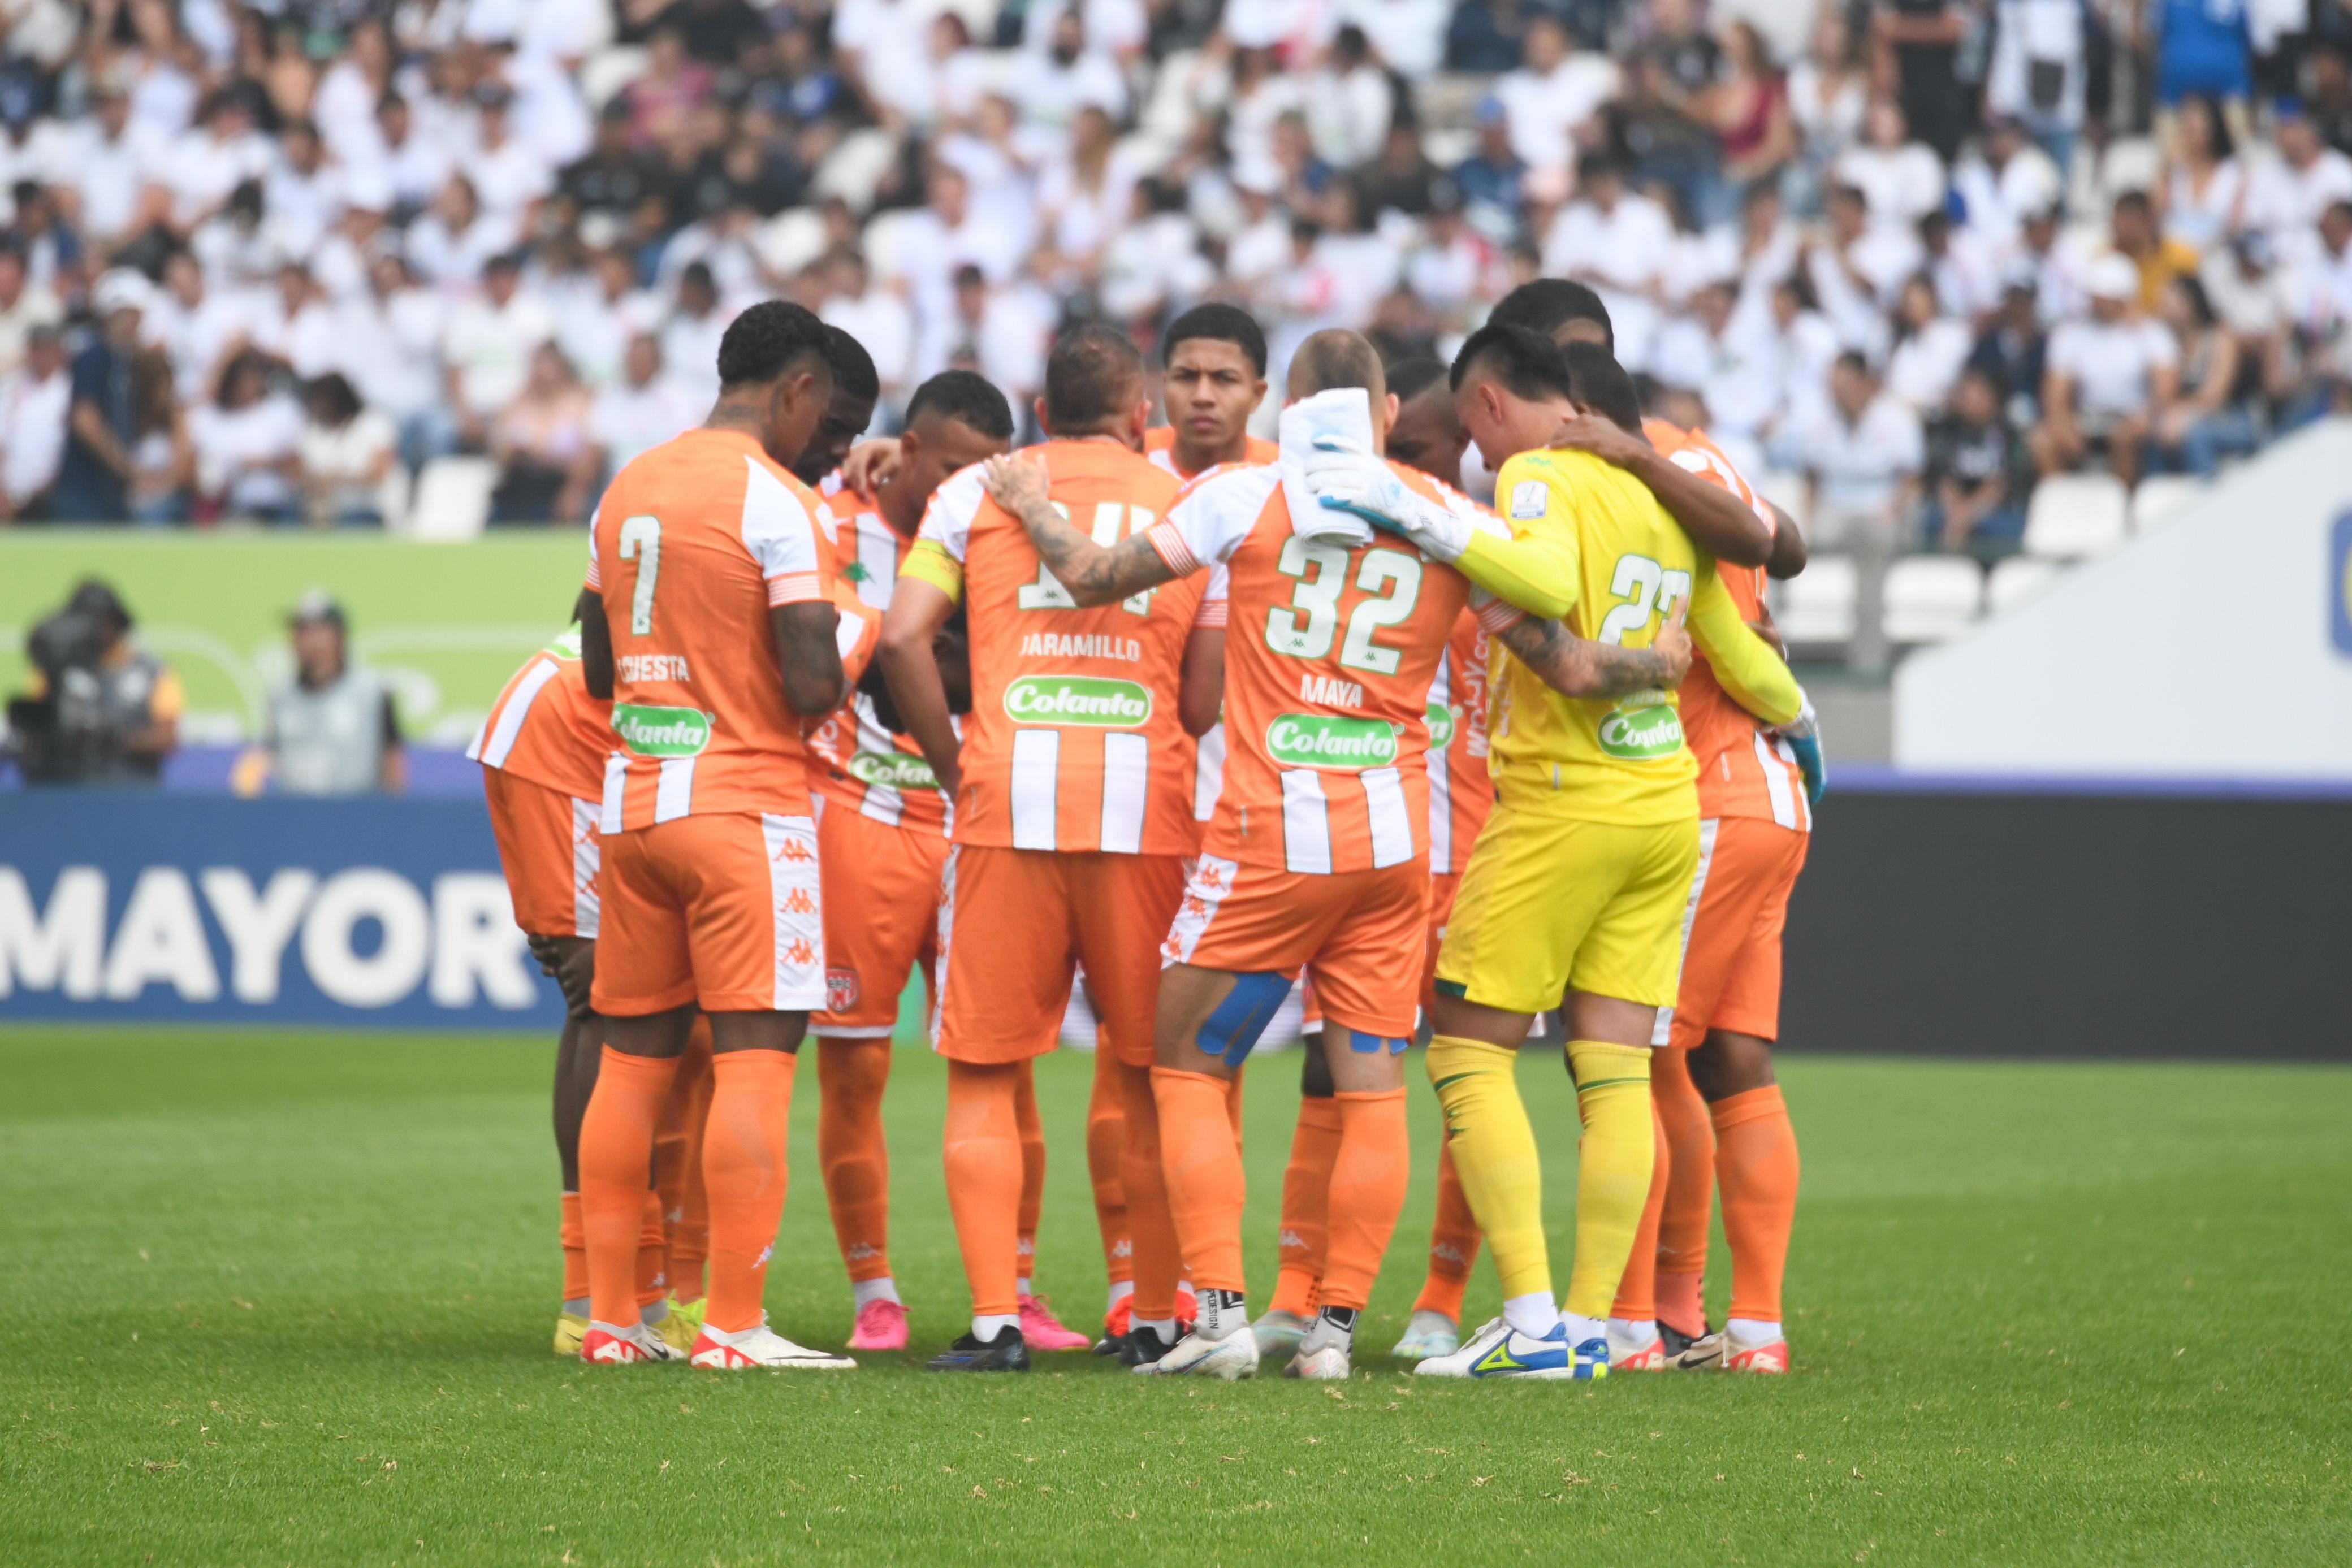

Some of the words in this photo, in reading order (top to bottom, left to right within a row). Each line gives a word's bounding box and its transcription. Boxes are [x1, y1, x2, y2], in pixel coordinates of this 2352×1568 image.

[619, 515, 662, 635] 7
[1264, 534, 1423, 675] 32
[1020, 633, 1142, 662] JARAMILLO
[1009, 685, 1145, 718] Colanta
[1300, 674, 1363, 708] MAYA
[1271, 722, 1393, 757] Colanta
